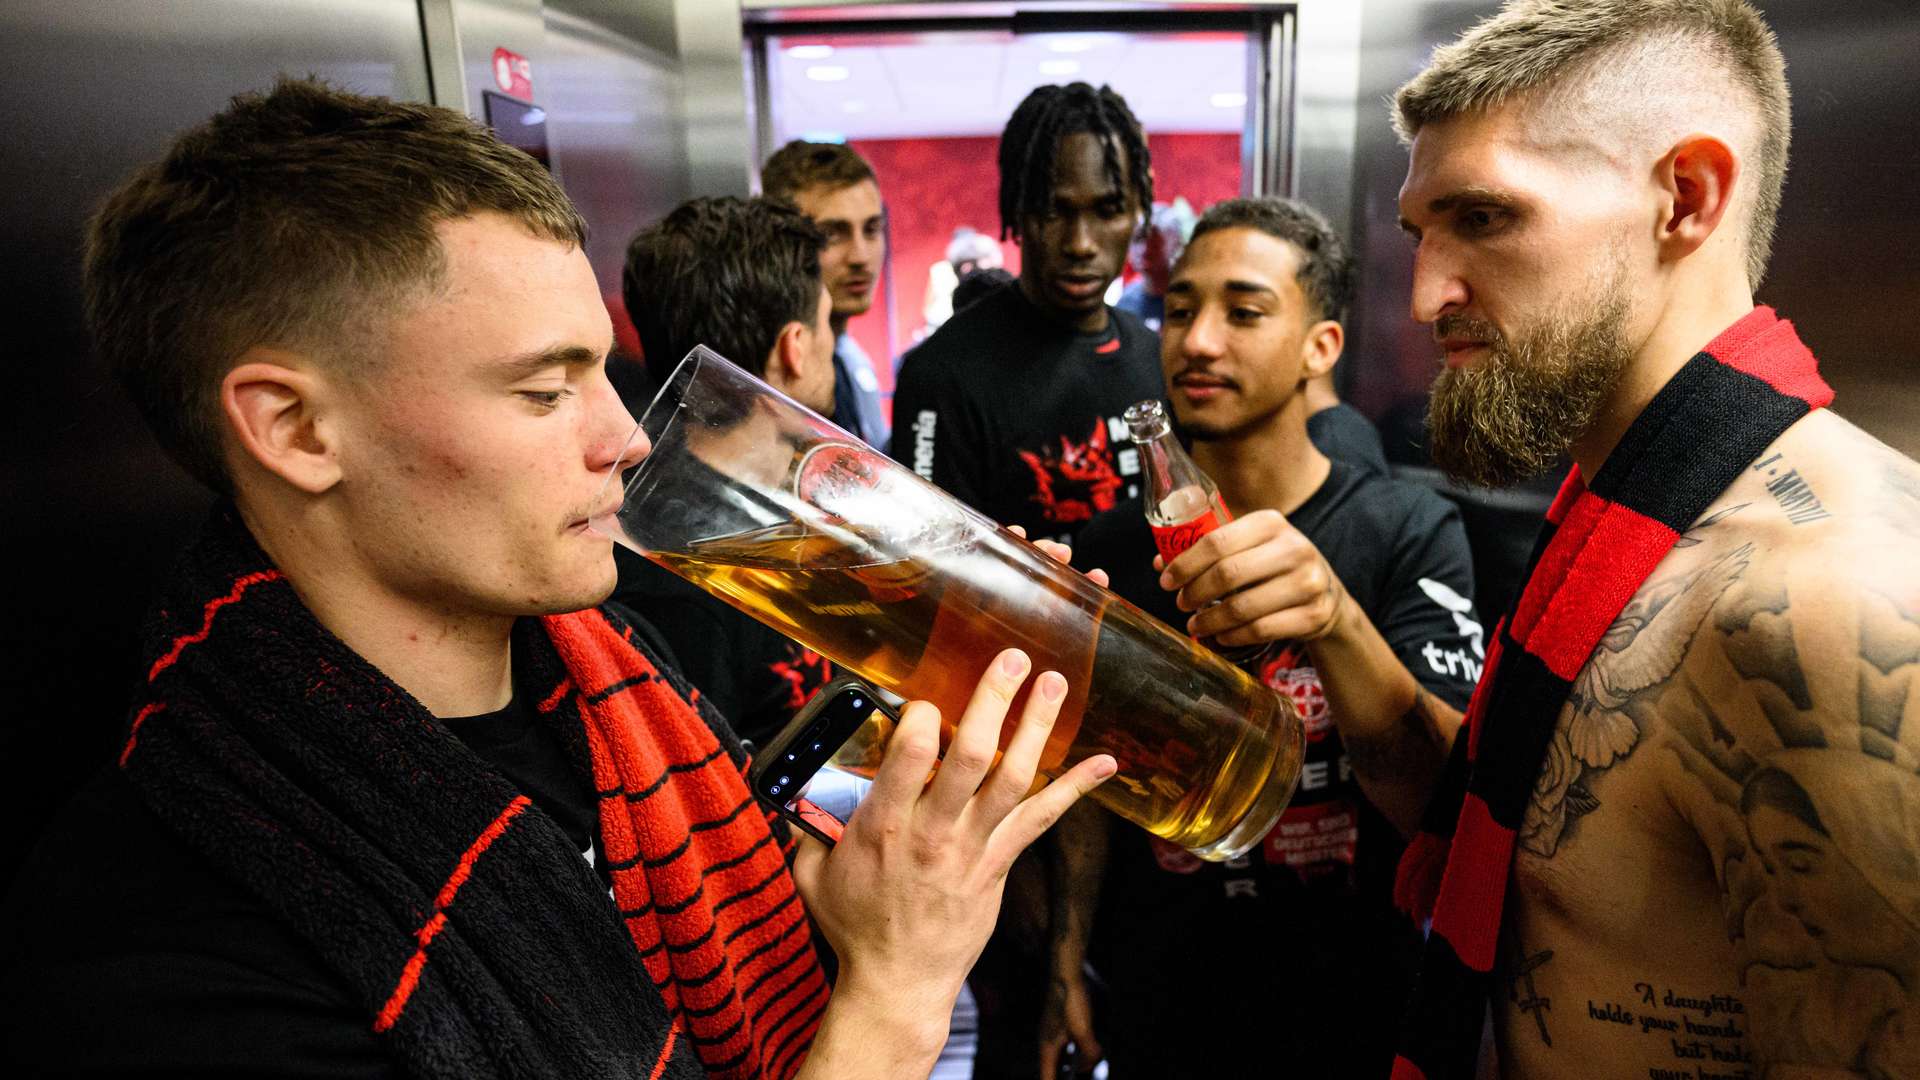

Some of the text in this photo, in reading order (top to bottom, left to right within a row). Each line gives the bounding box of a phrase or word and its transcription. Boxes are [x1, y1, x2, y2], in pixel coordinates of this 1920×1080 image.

[910, 409, 938, 482] menia
[1420, 639, 1485, 685] triv
[1663, 988, 1745, 1017] daughte
[1638, 1014, 1680, 1034] your
